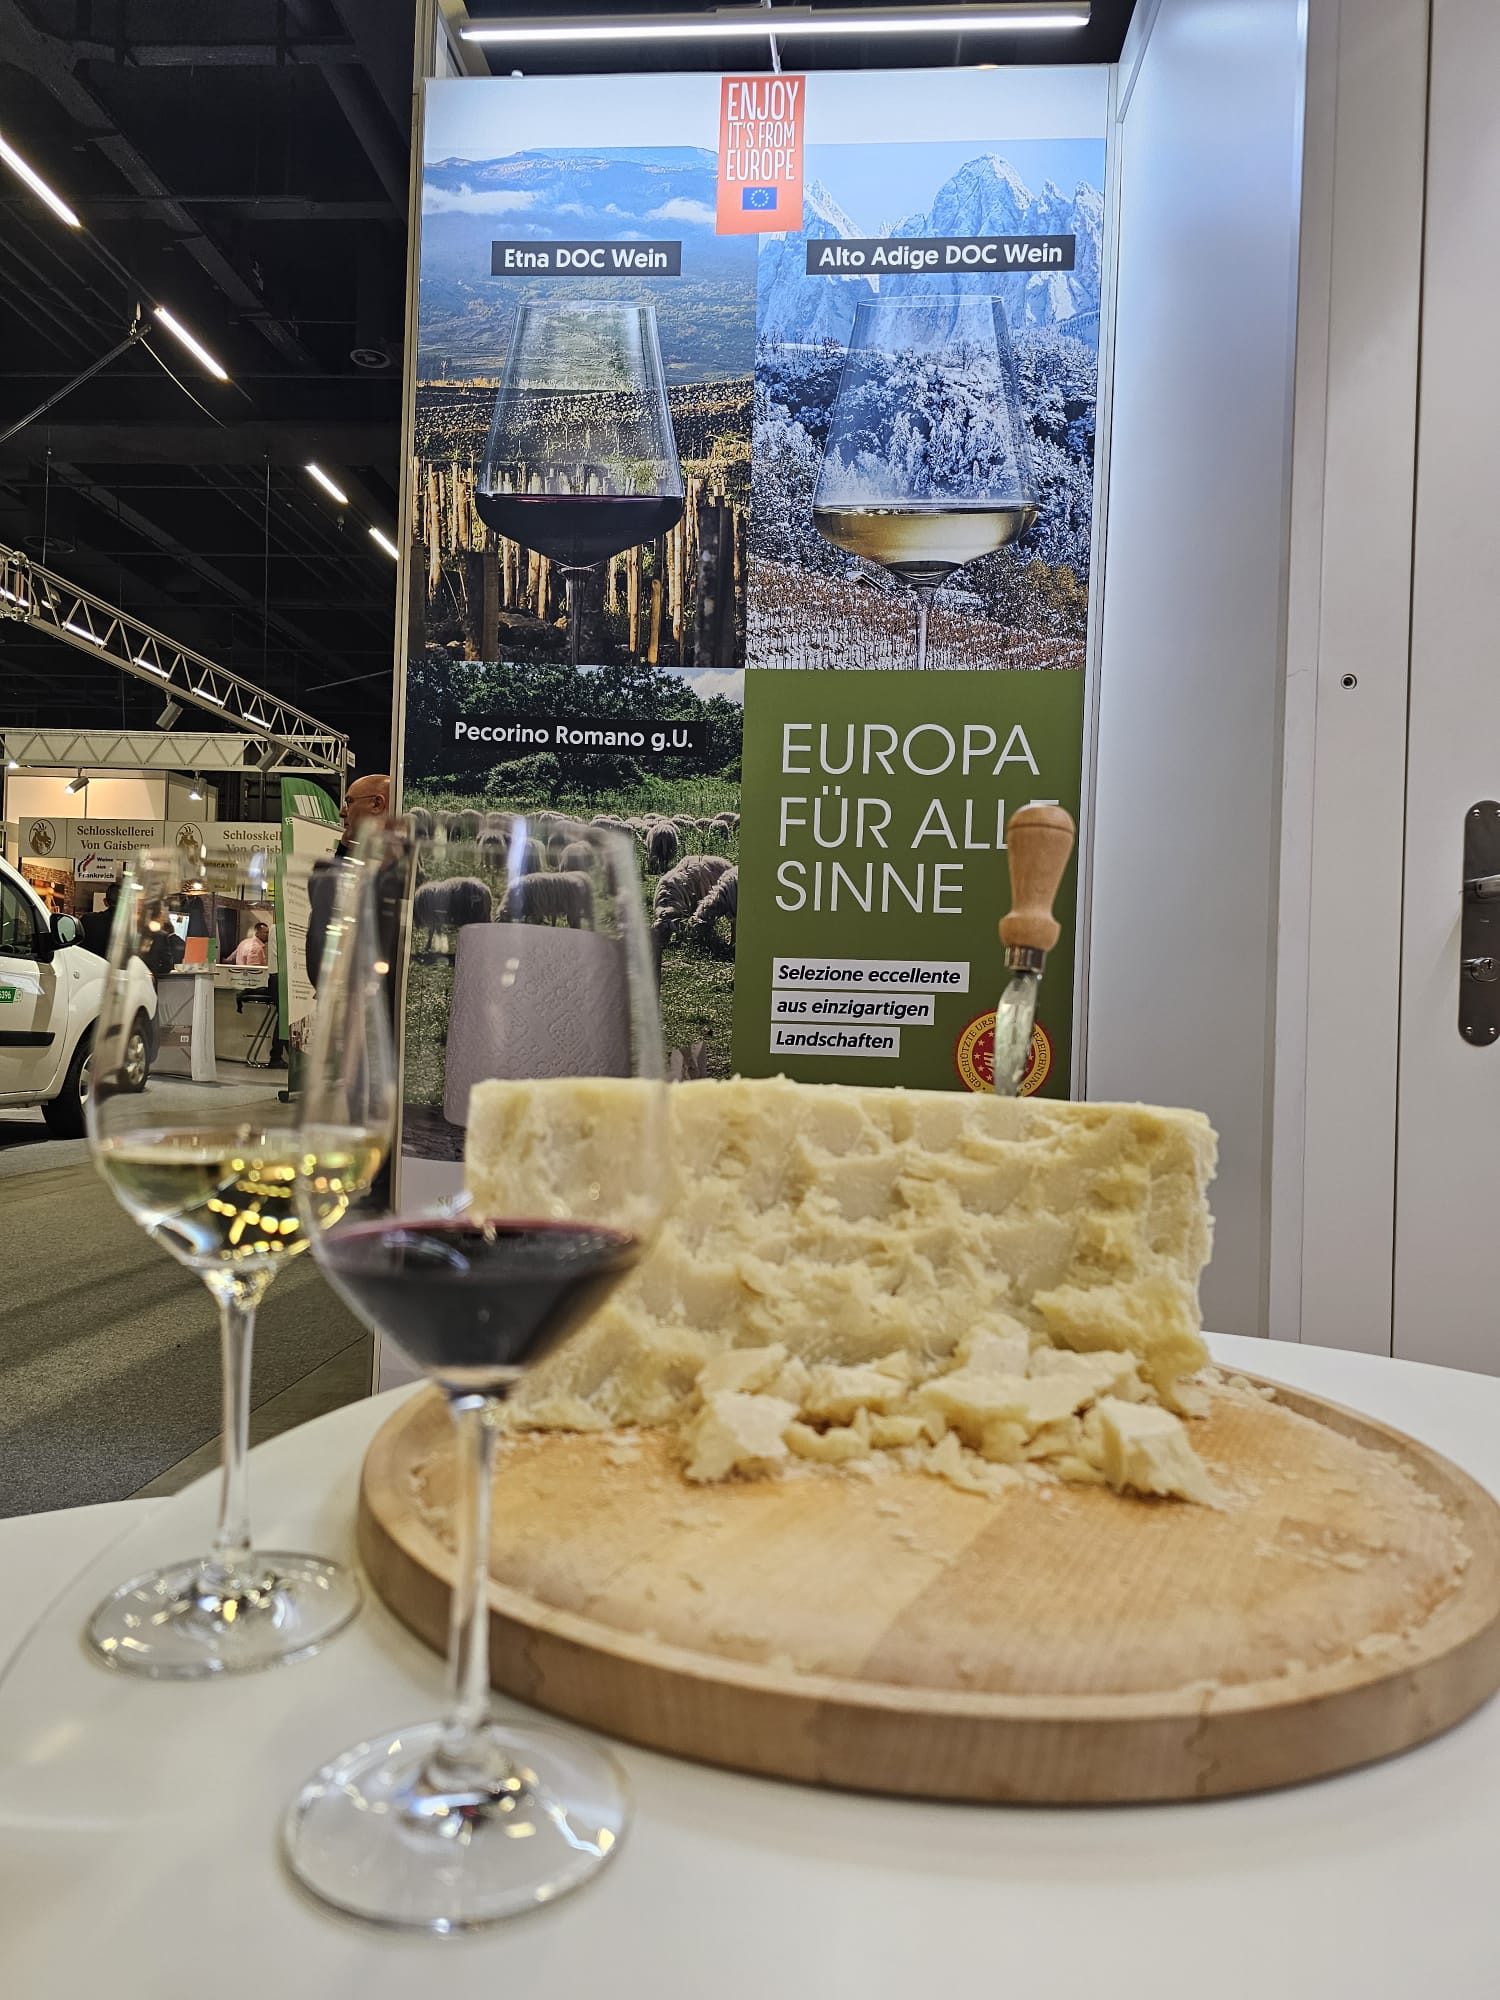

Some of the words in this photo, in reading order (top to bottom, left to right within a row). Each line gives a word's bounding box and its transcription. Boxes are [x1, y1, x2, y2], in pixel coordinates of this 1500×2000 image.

[727, 81, 799, 121] ENJOY
[728, 121, 754, 149] IT'S
[758, 121, 795, 148] FROM
[726, 149, 795, 181] EUROPE
[504, 248, 550, 268] Etna
[556, 248, 605, 268] DOC
[611, 247, 667, 268] Wein
[818, 247, 866, 267] Alto
[870, 245, 939, 270] Adige
[945, 244, 998, 265] DOC
[1003, 243, 1062, 263] Wein
[454, 721, 549, 744] Pecorino
[555, 725, 645, 747] Romano
[651, 729, 693, 751] g.U.
[782, 723, 1041, 776] EUROPA
[77, 825, 154, 837] Schlosskellerei
[779, 785, 892, 849] FÜR
[910, 798, 1059, 850] ALL
[81, 839, 100, 850] Von
[775, 860, 964, 914] SINNE
[778, 965, 864, 982] Selezione
[868, 968, 961, 984] eccellente
[776, 1000, 807, 1013] aus
[811, 999, 929, 1019] einzigartigen
[776, 1030, 894, 1049] Landschaften
